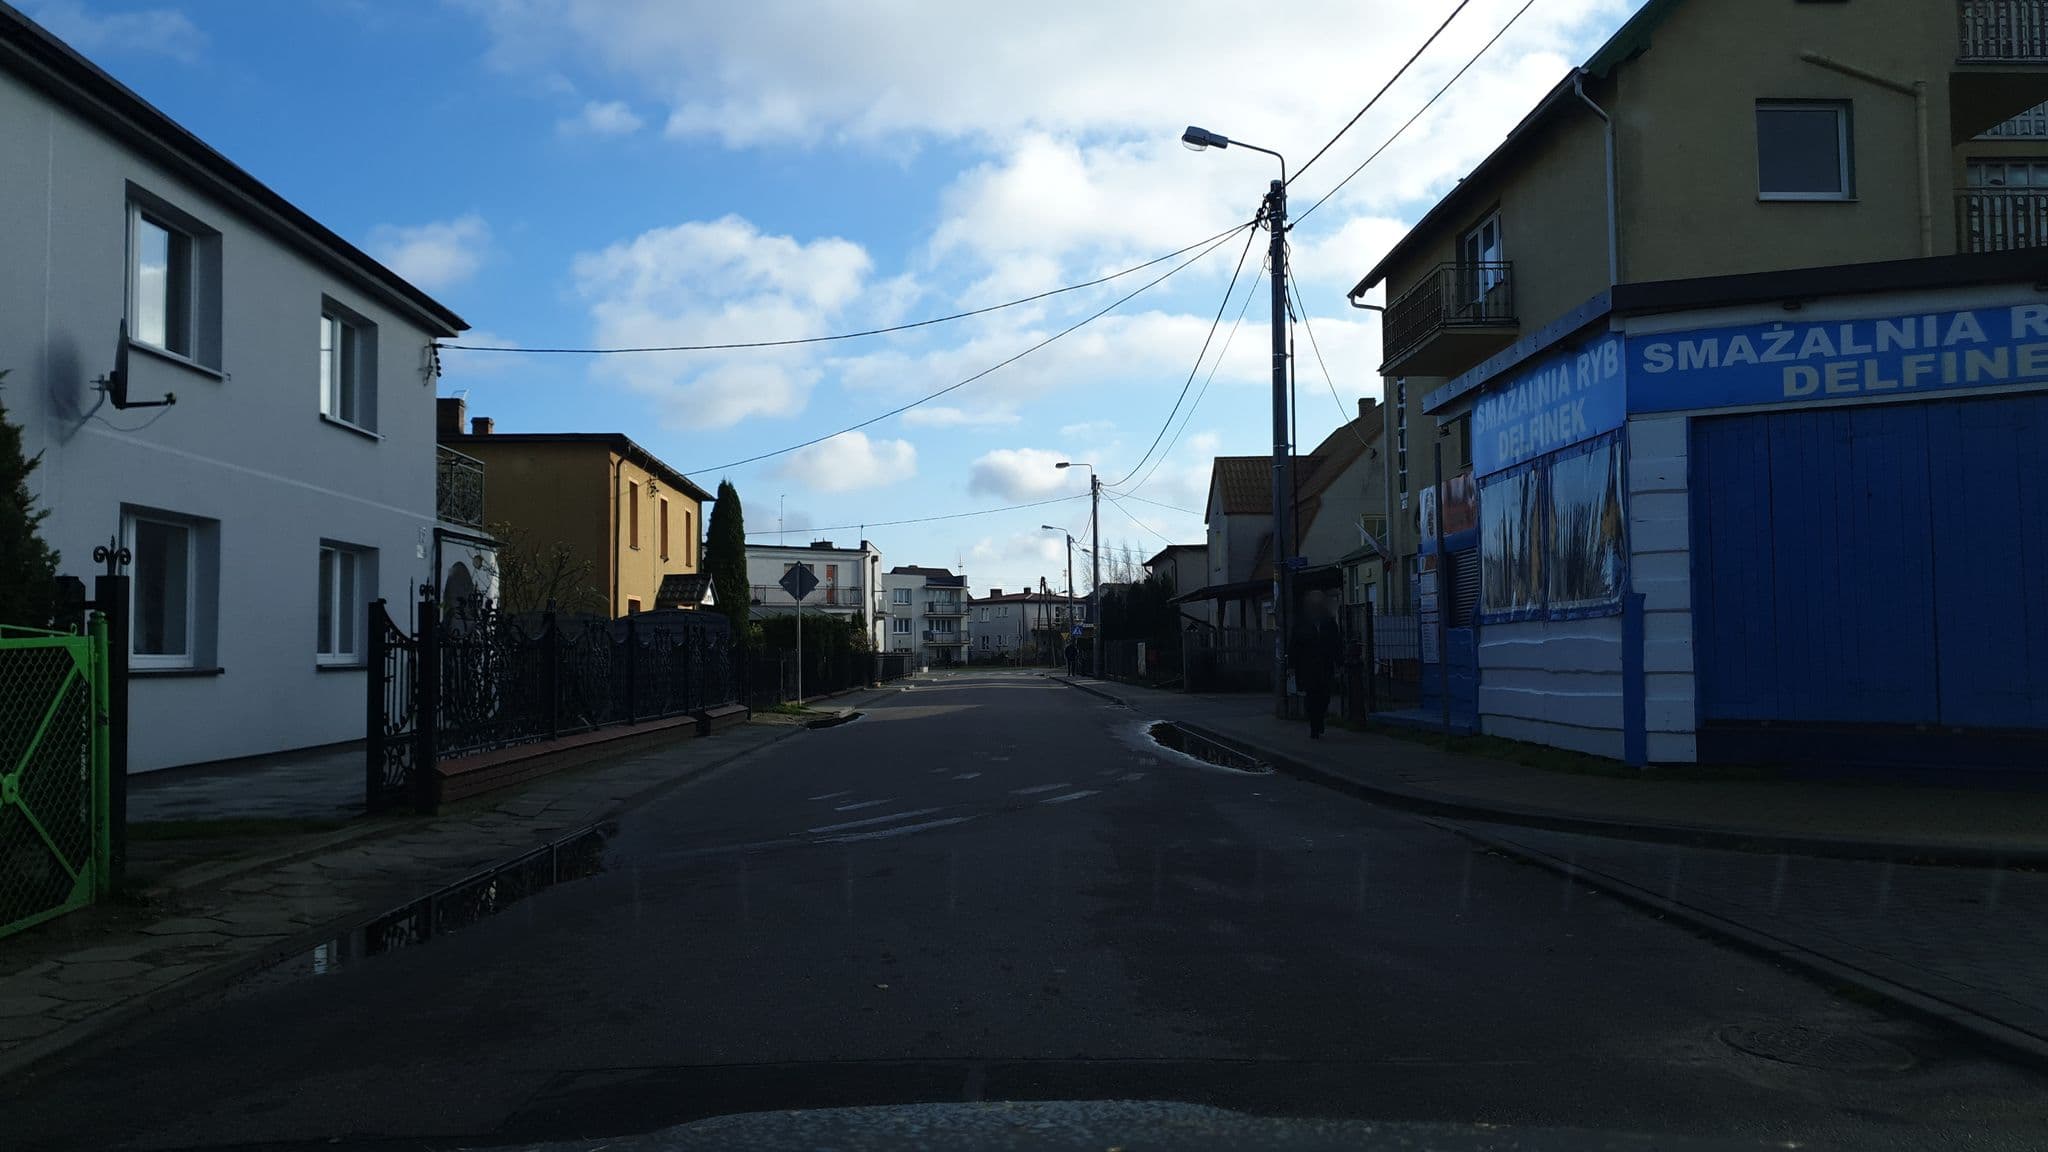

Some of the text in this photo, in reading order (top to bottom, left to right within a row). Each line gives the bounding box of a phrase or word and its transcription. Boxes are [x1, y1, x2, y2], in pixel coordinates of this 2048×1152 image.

[1642, 310, 1988, 375] SMAŻALNIA
[1783, 342, 2048, 398] DELFINE
[1476, 339, 1619, 435] SMAŻALNIA RYB
[1500, 398, 1586, 459] DELFINEK
